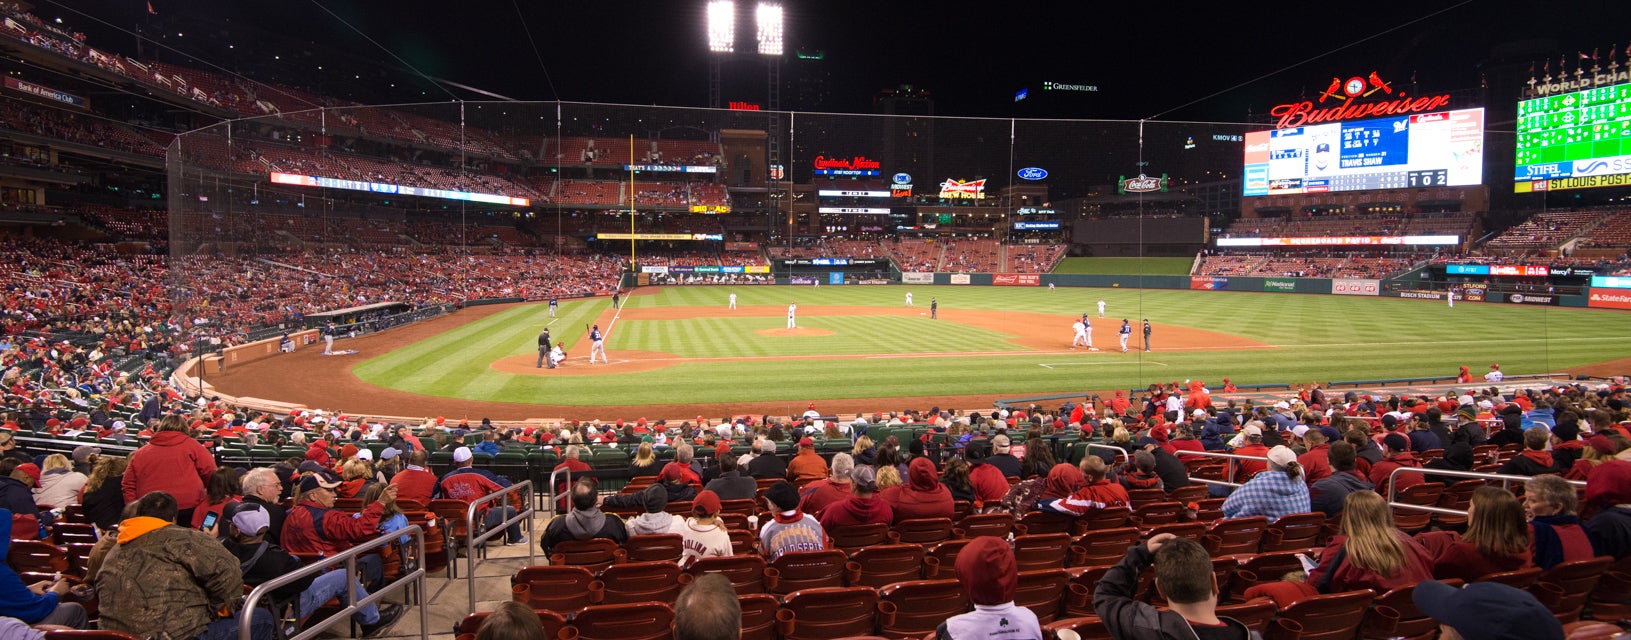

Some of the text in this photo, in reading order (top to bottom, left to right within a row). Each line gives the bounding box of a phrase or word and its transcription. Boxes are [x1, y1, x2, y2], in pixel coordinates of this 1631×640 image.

[1537, 78, 1591, 95] WORLD
[18, 82, 74, 104] Bank of America Club
[729, 101, 759, 111] Hilton
[1270, 92, 1450, 130] Budweiser
[1341, 157, 1383, 167] TRAVIS SHAW
[1023, 168, 1042, 178] Ford
[1527, 163, 1561, 176] STIFEL
[1128, 180, 1156, 189] Coca-Cola
[1411, 175, 1446, 186] 1 0 2
[1533, 180, 1547, 190] stl
[1567, 176, 1596, 188] LOUIS
[1601, 294, 1618, 302] State
